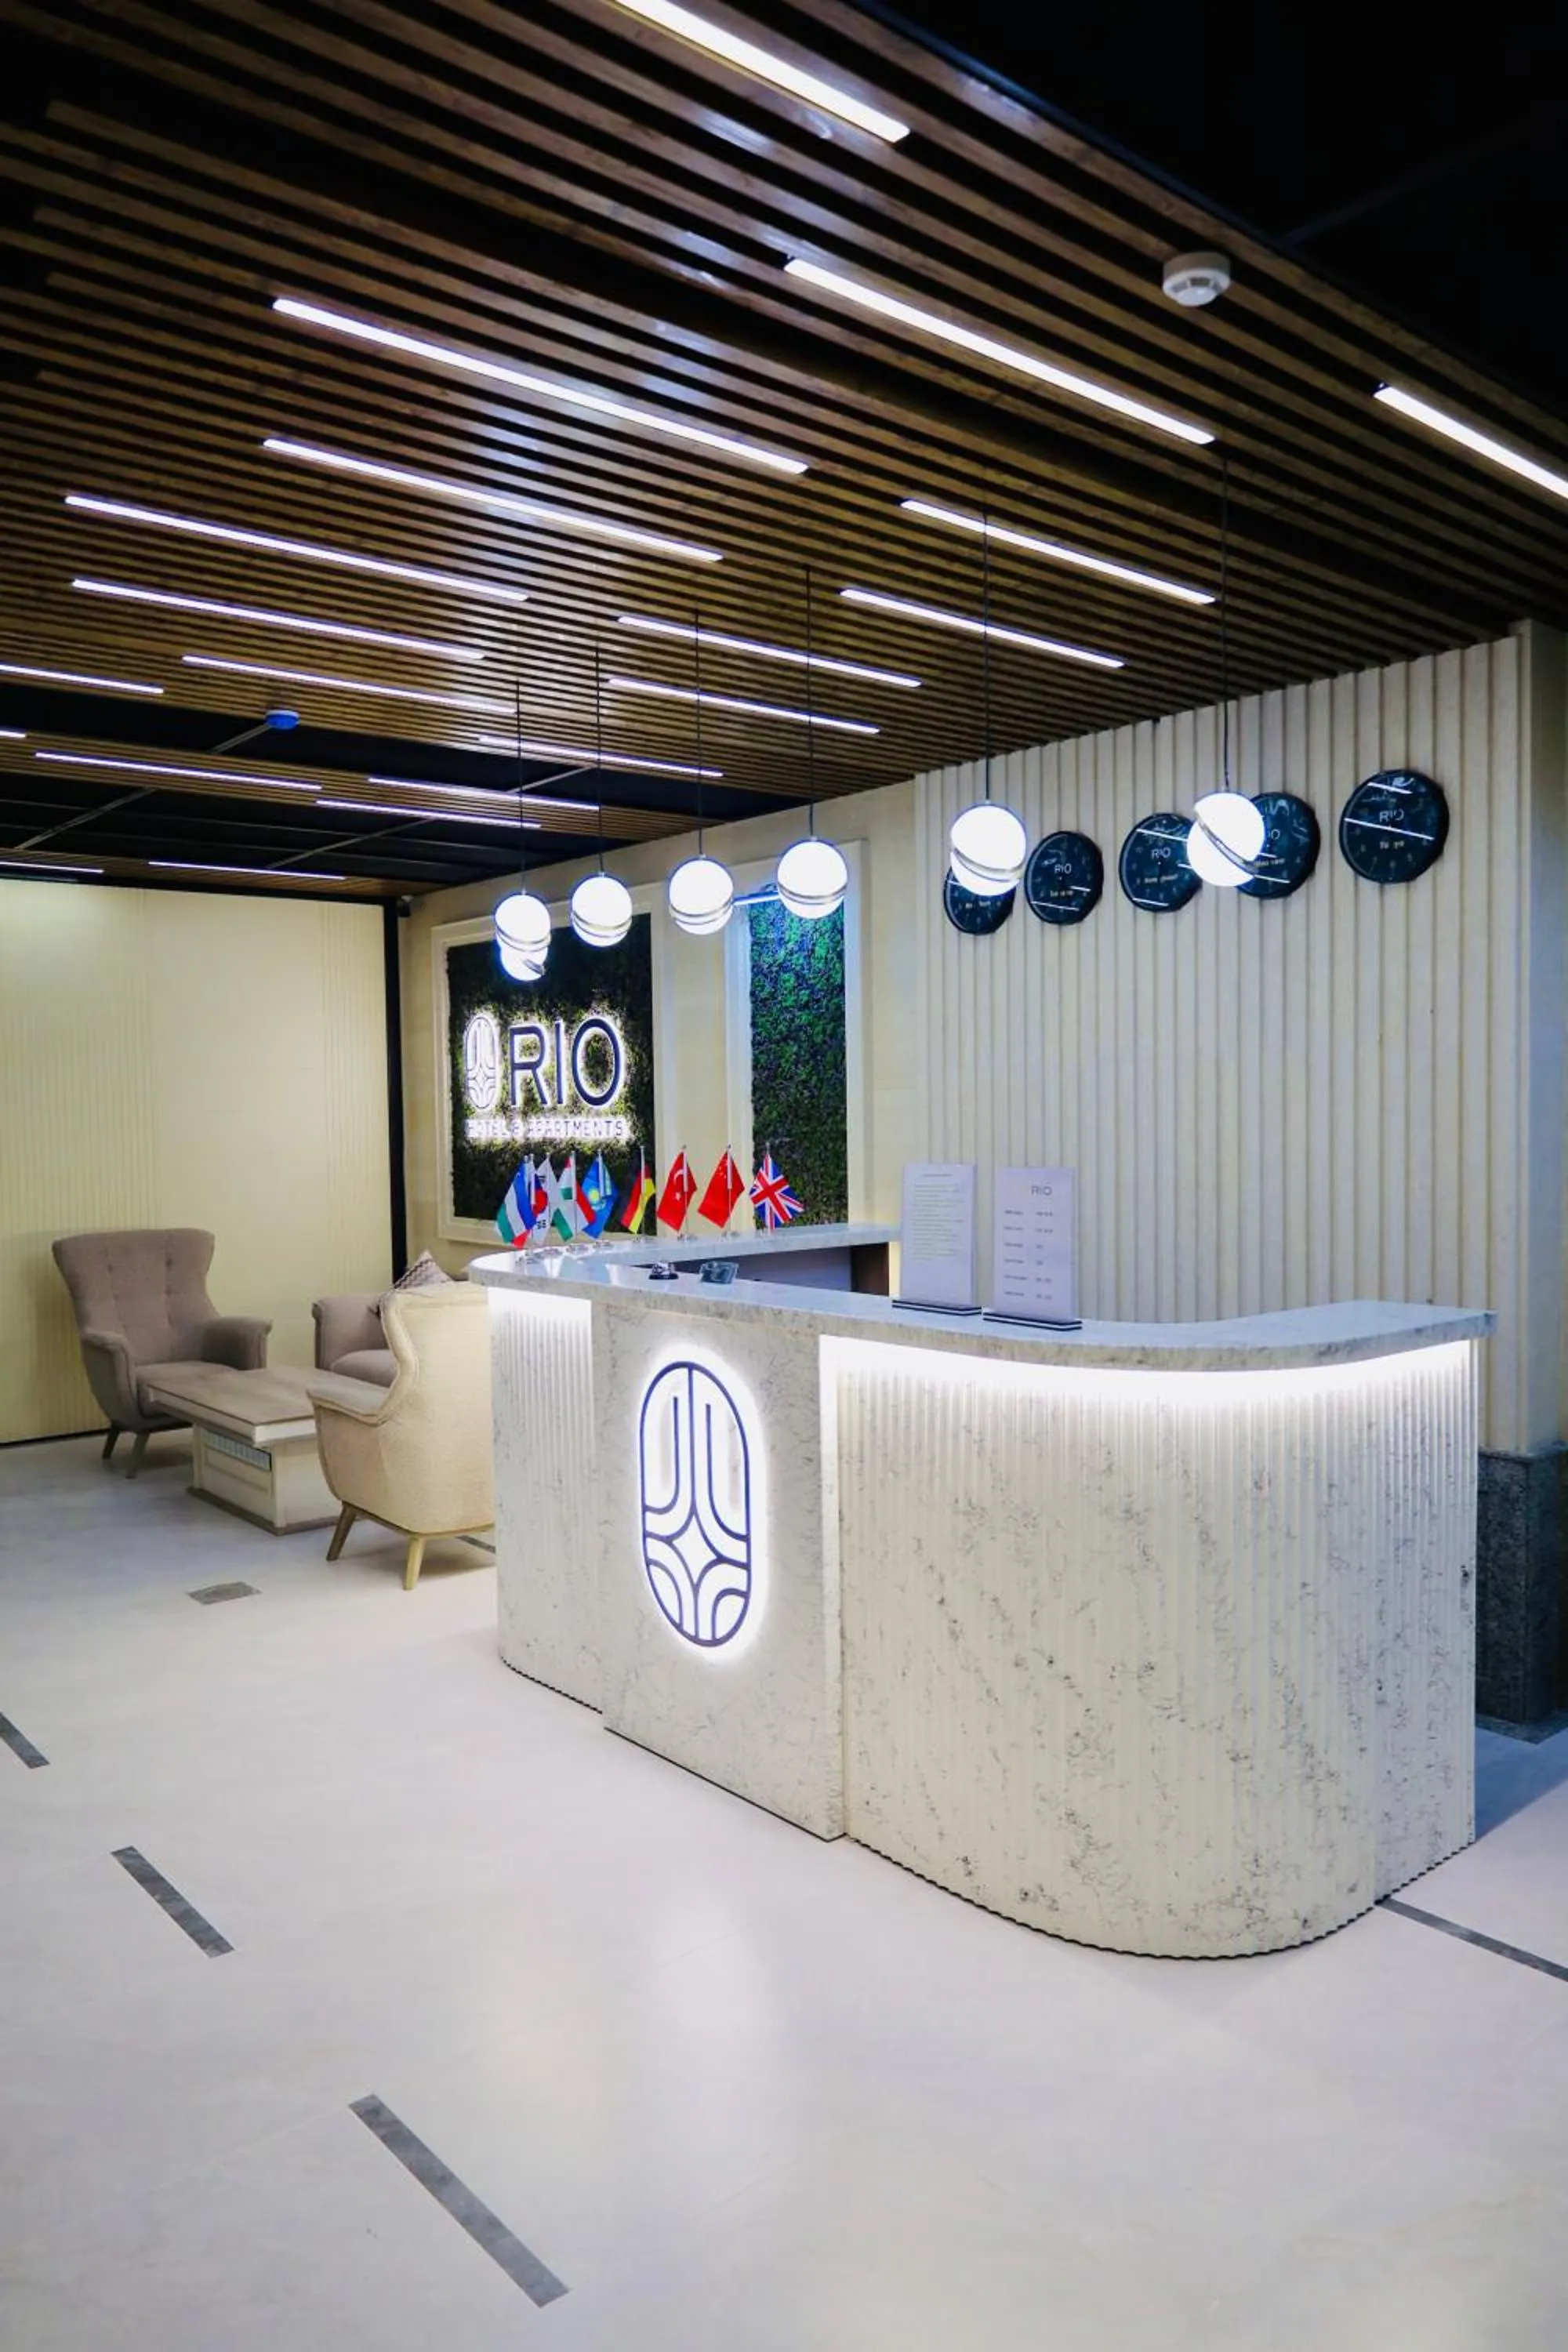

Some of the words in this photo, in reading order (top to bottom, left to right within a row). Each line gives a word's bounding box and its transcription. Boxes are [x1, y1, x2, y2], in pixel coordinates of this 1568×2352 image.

[1151, 847, 1171, 860] RIO
[1054, 862, 1073, 875] RIO
[508, 1018, 620, 1107] RIO
[1030, 1185, 1053, 1196] RIO
